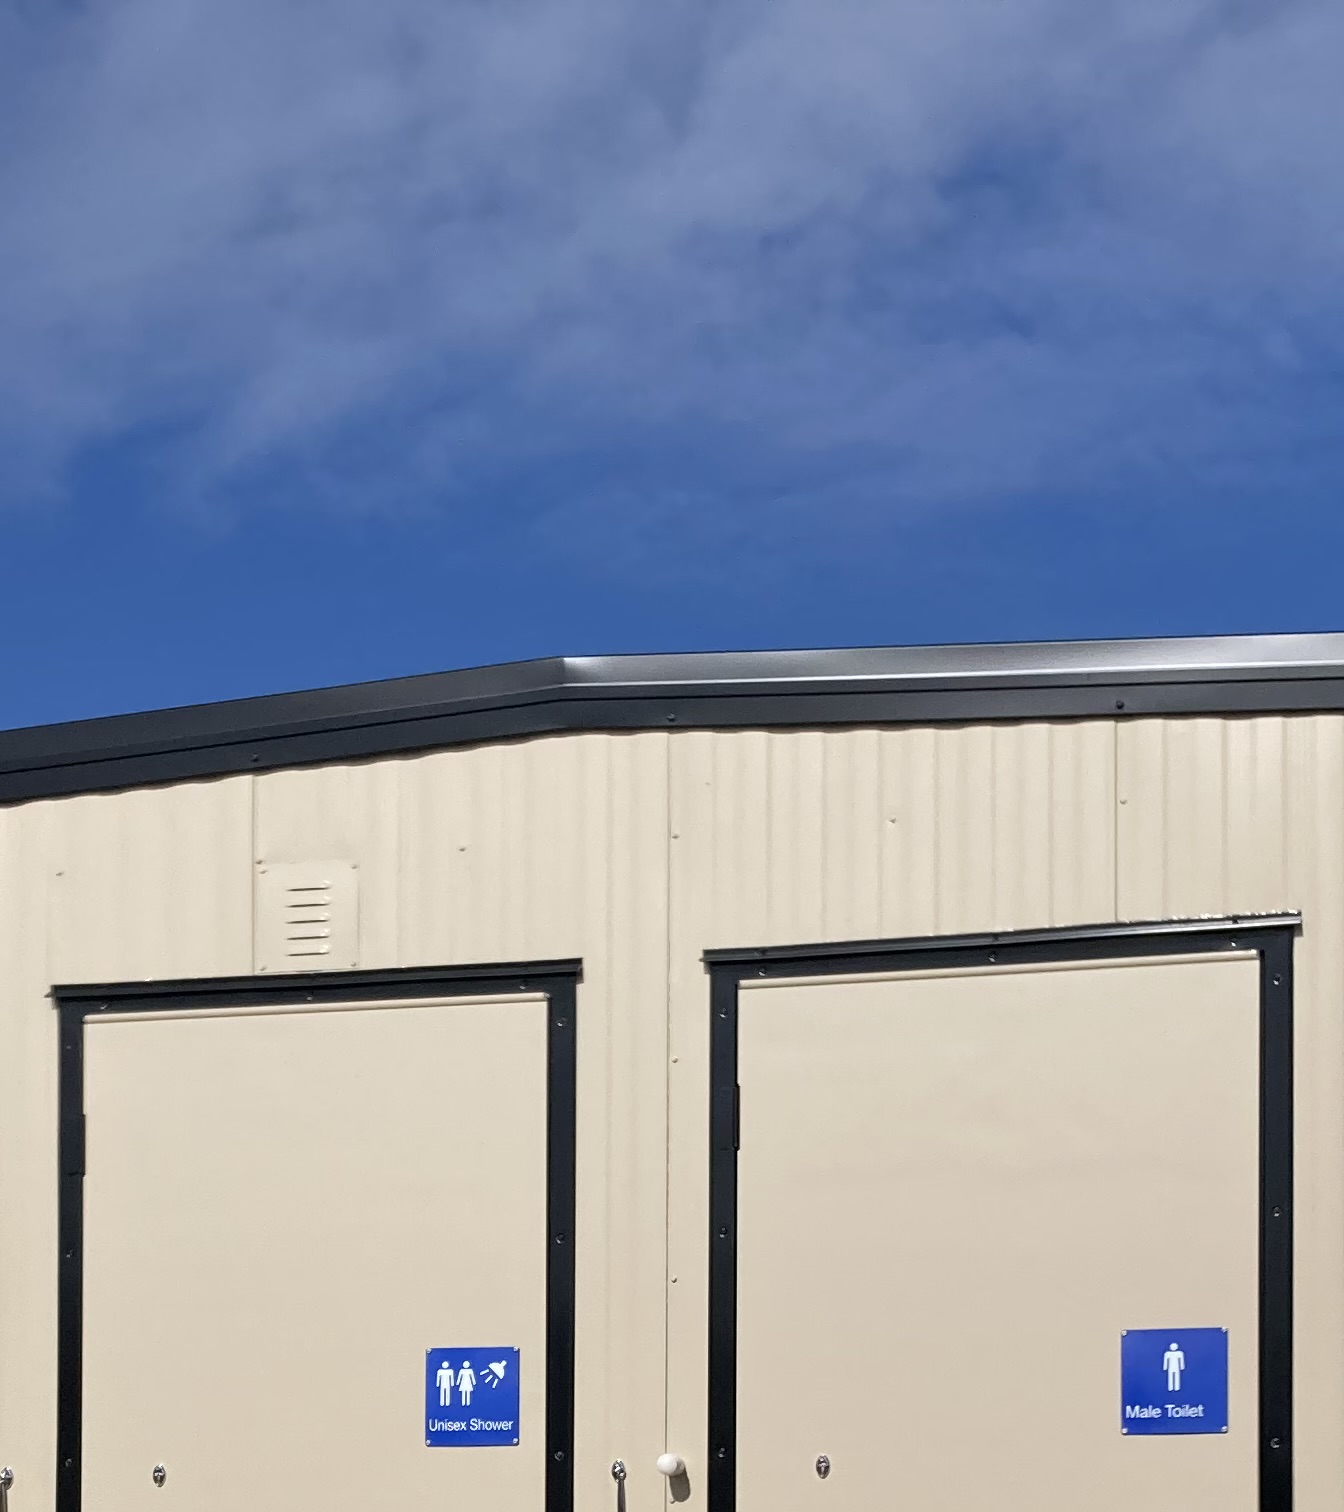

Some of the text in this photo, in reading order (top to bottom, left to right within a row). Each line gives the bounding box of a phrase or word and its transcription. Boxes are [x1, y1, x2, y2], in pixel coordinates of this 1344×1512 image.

[1125, 1404, 1205, 1419] Male Toilet
[428, 1417, 514, 1432] Unisex Shower
